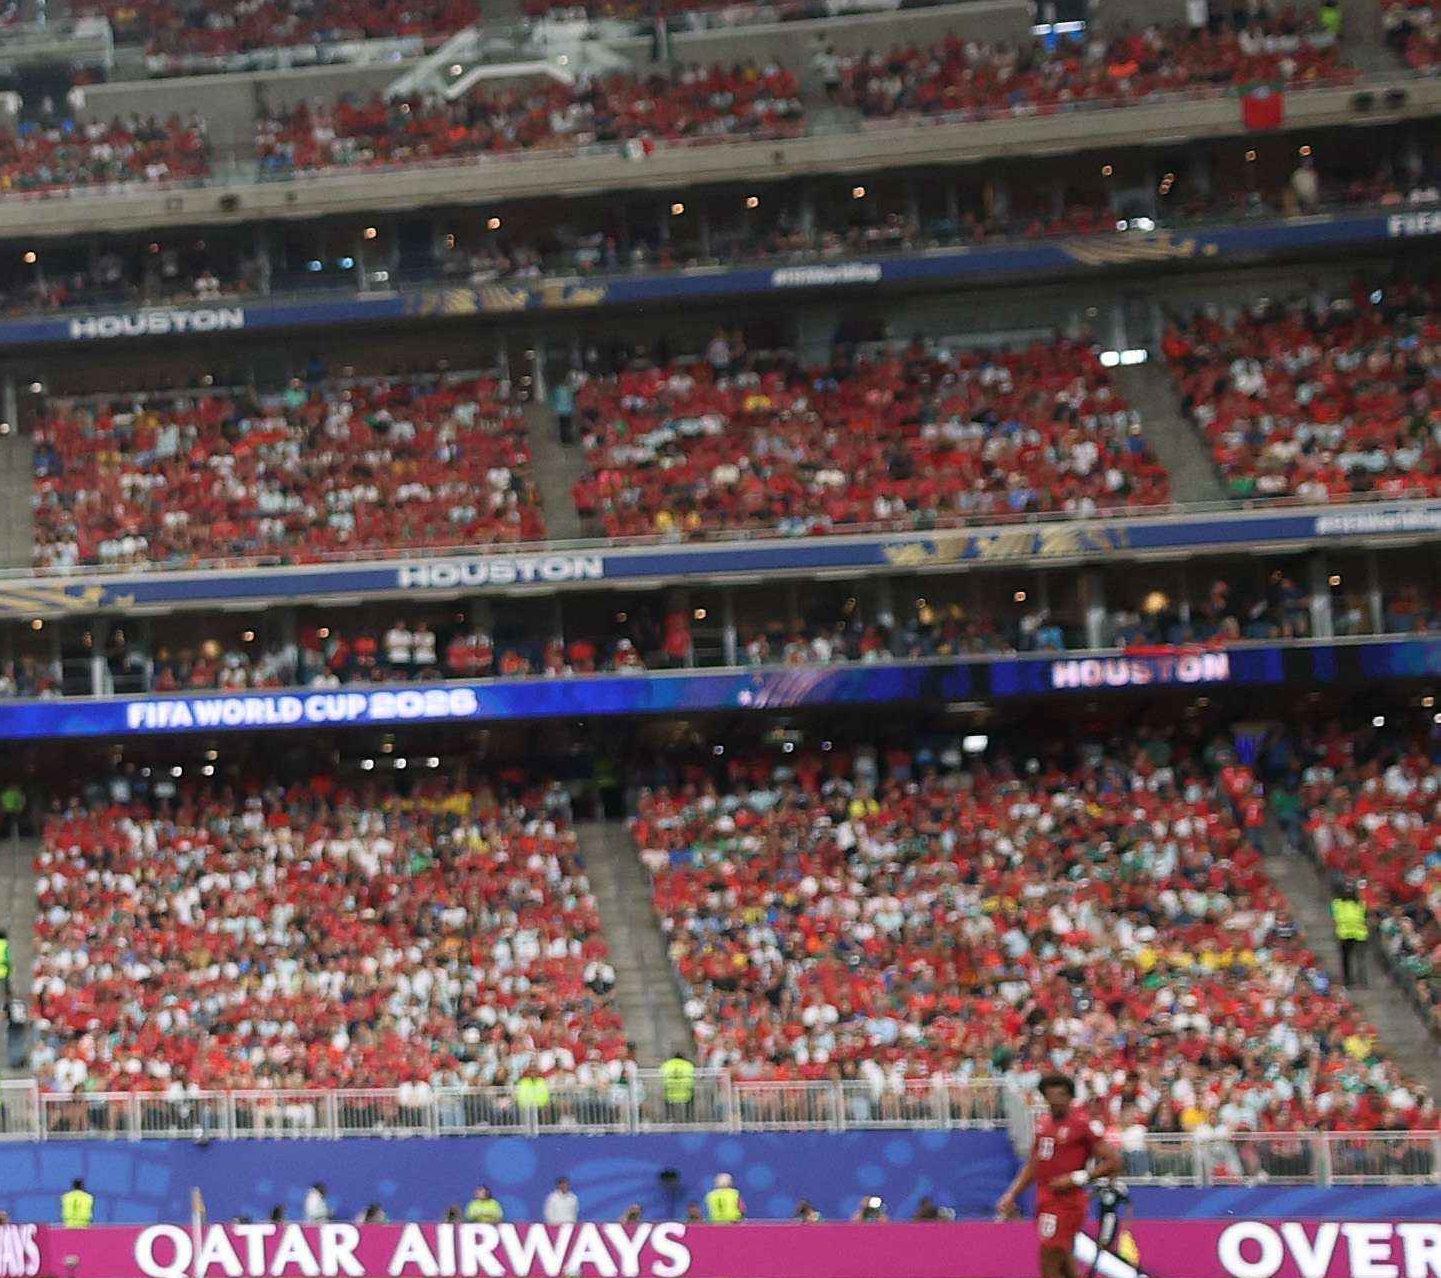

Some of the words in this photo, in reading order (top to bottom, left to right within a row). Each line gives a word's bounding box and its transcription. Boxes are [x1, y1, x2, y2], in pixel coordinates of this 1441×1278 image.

[69, 307, 245, 339] HOUSTON
[397, 556, 604, 589] HOUSTON
[1052, 652, 1230, 689] HOUSTON
[126, 700, 193, 729] FIFA
[191, 695, 304, 727] WORLD
[303, 692, 368, 723] CUP
[368, 687, 479, 720] 2026
